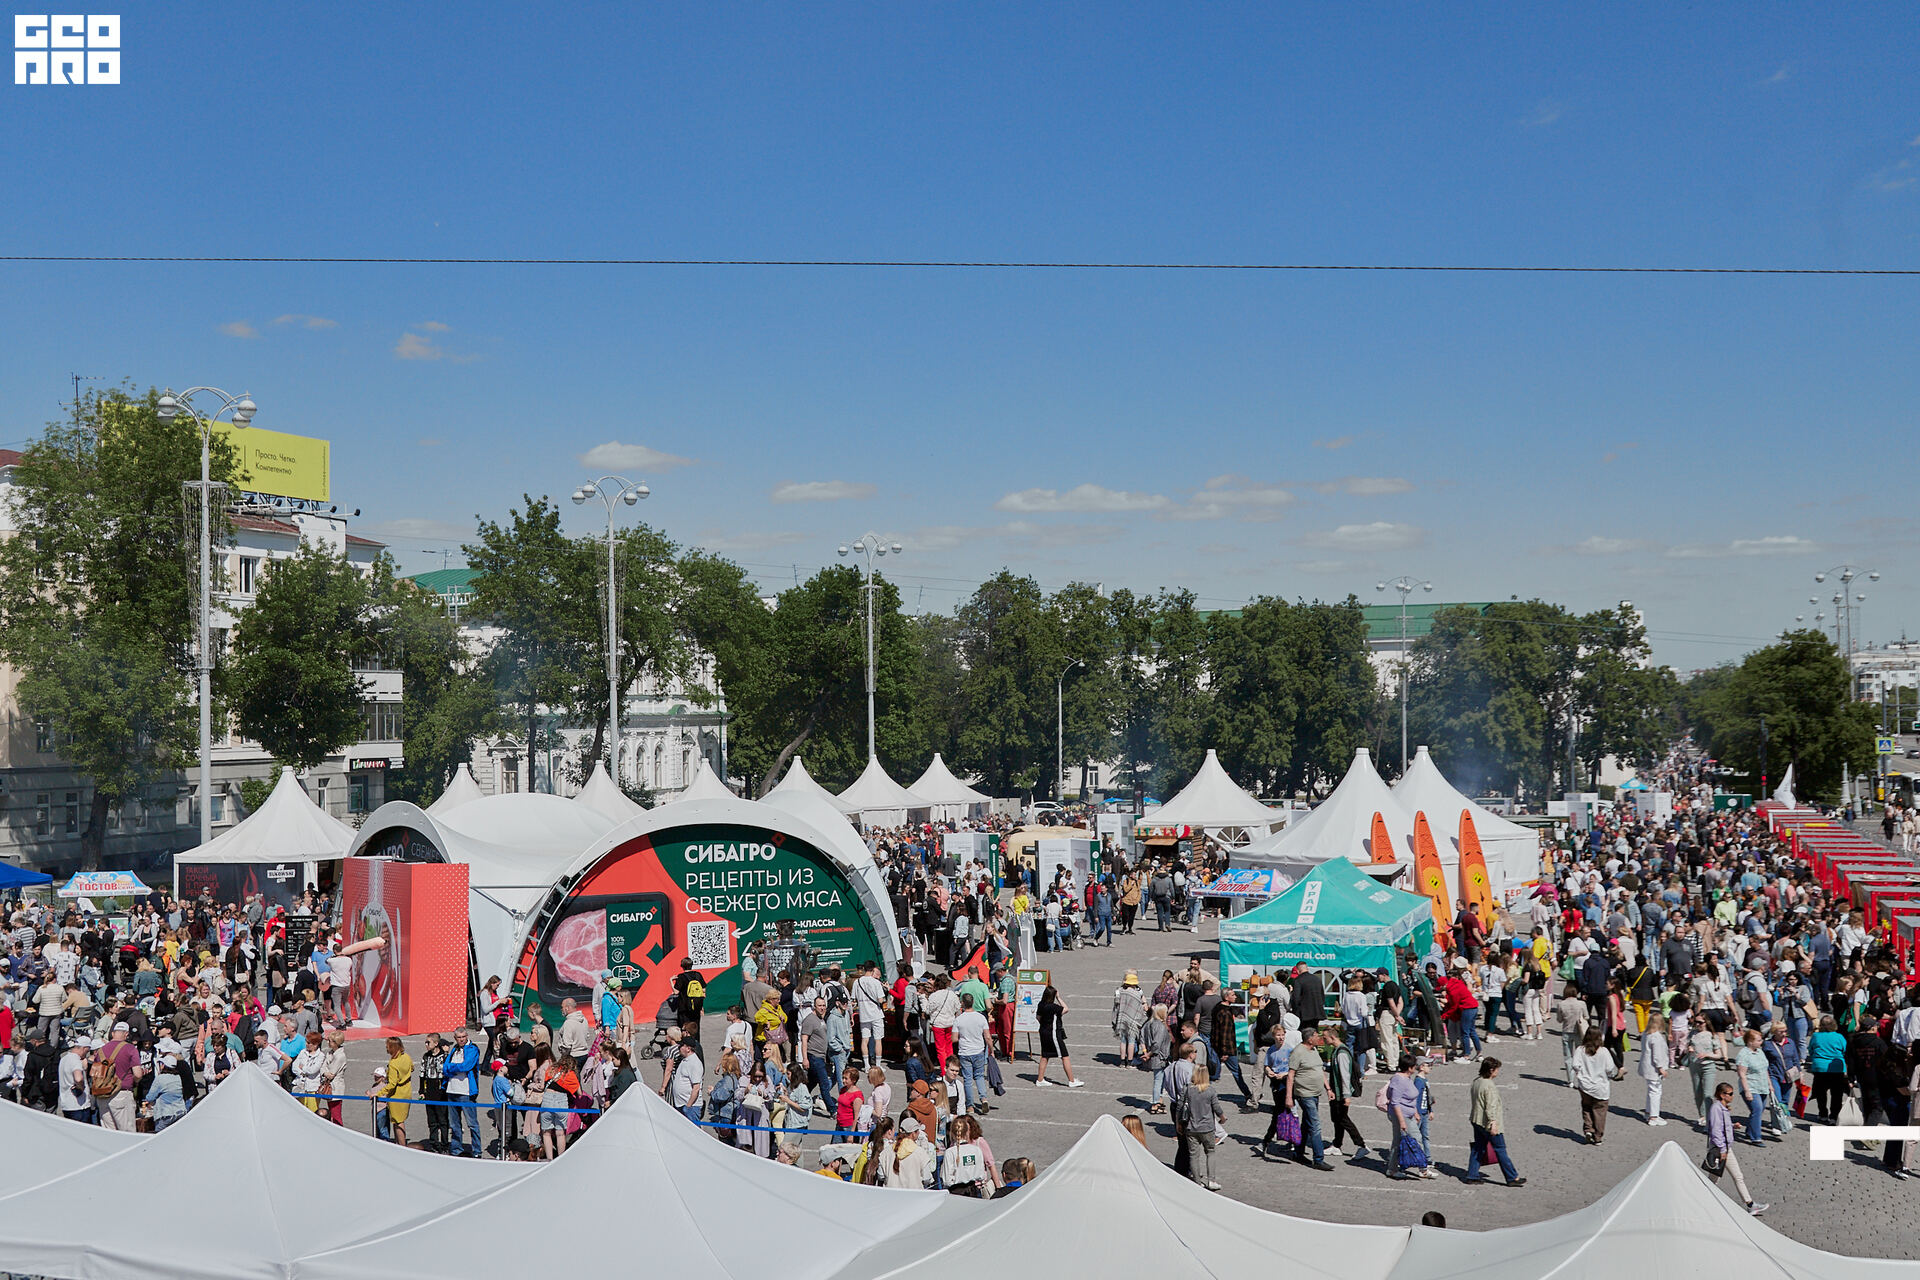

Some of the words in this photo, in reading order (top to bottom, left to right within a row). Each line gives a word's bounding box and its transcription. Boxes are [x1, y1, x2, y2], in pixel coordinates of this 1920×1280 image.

[684, 842, 777, 864] СИБАГРО
[685, 869, 783, 892] РЕЦЕПТЫ
[788, 867, 815, 886] ИЗ
[685, 893, 781, 914] СВЕЖЕГО
[786, 889, 843, 909] МЯСА
[1304, 883, 1318, 911] УРАЛ
[610, 911, 653, 923] СИБАГРО
[1271, 950, 1336, 960] gotoural.com
